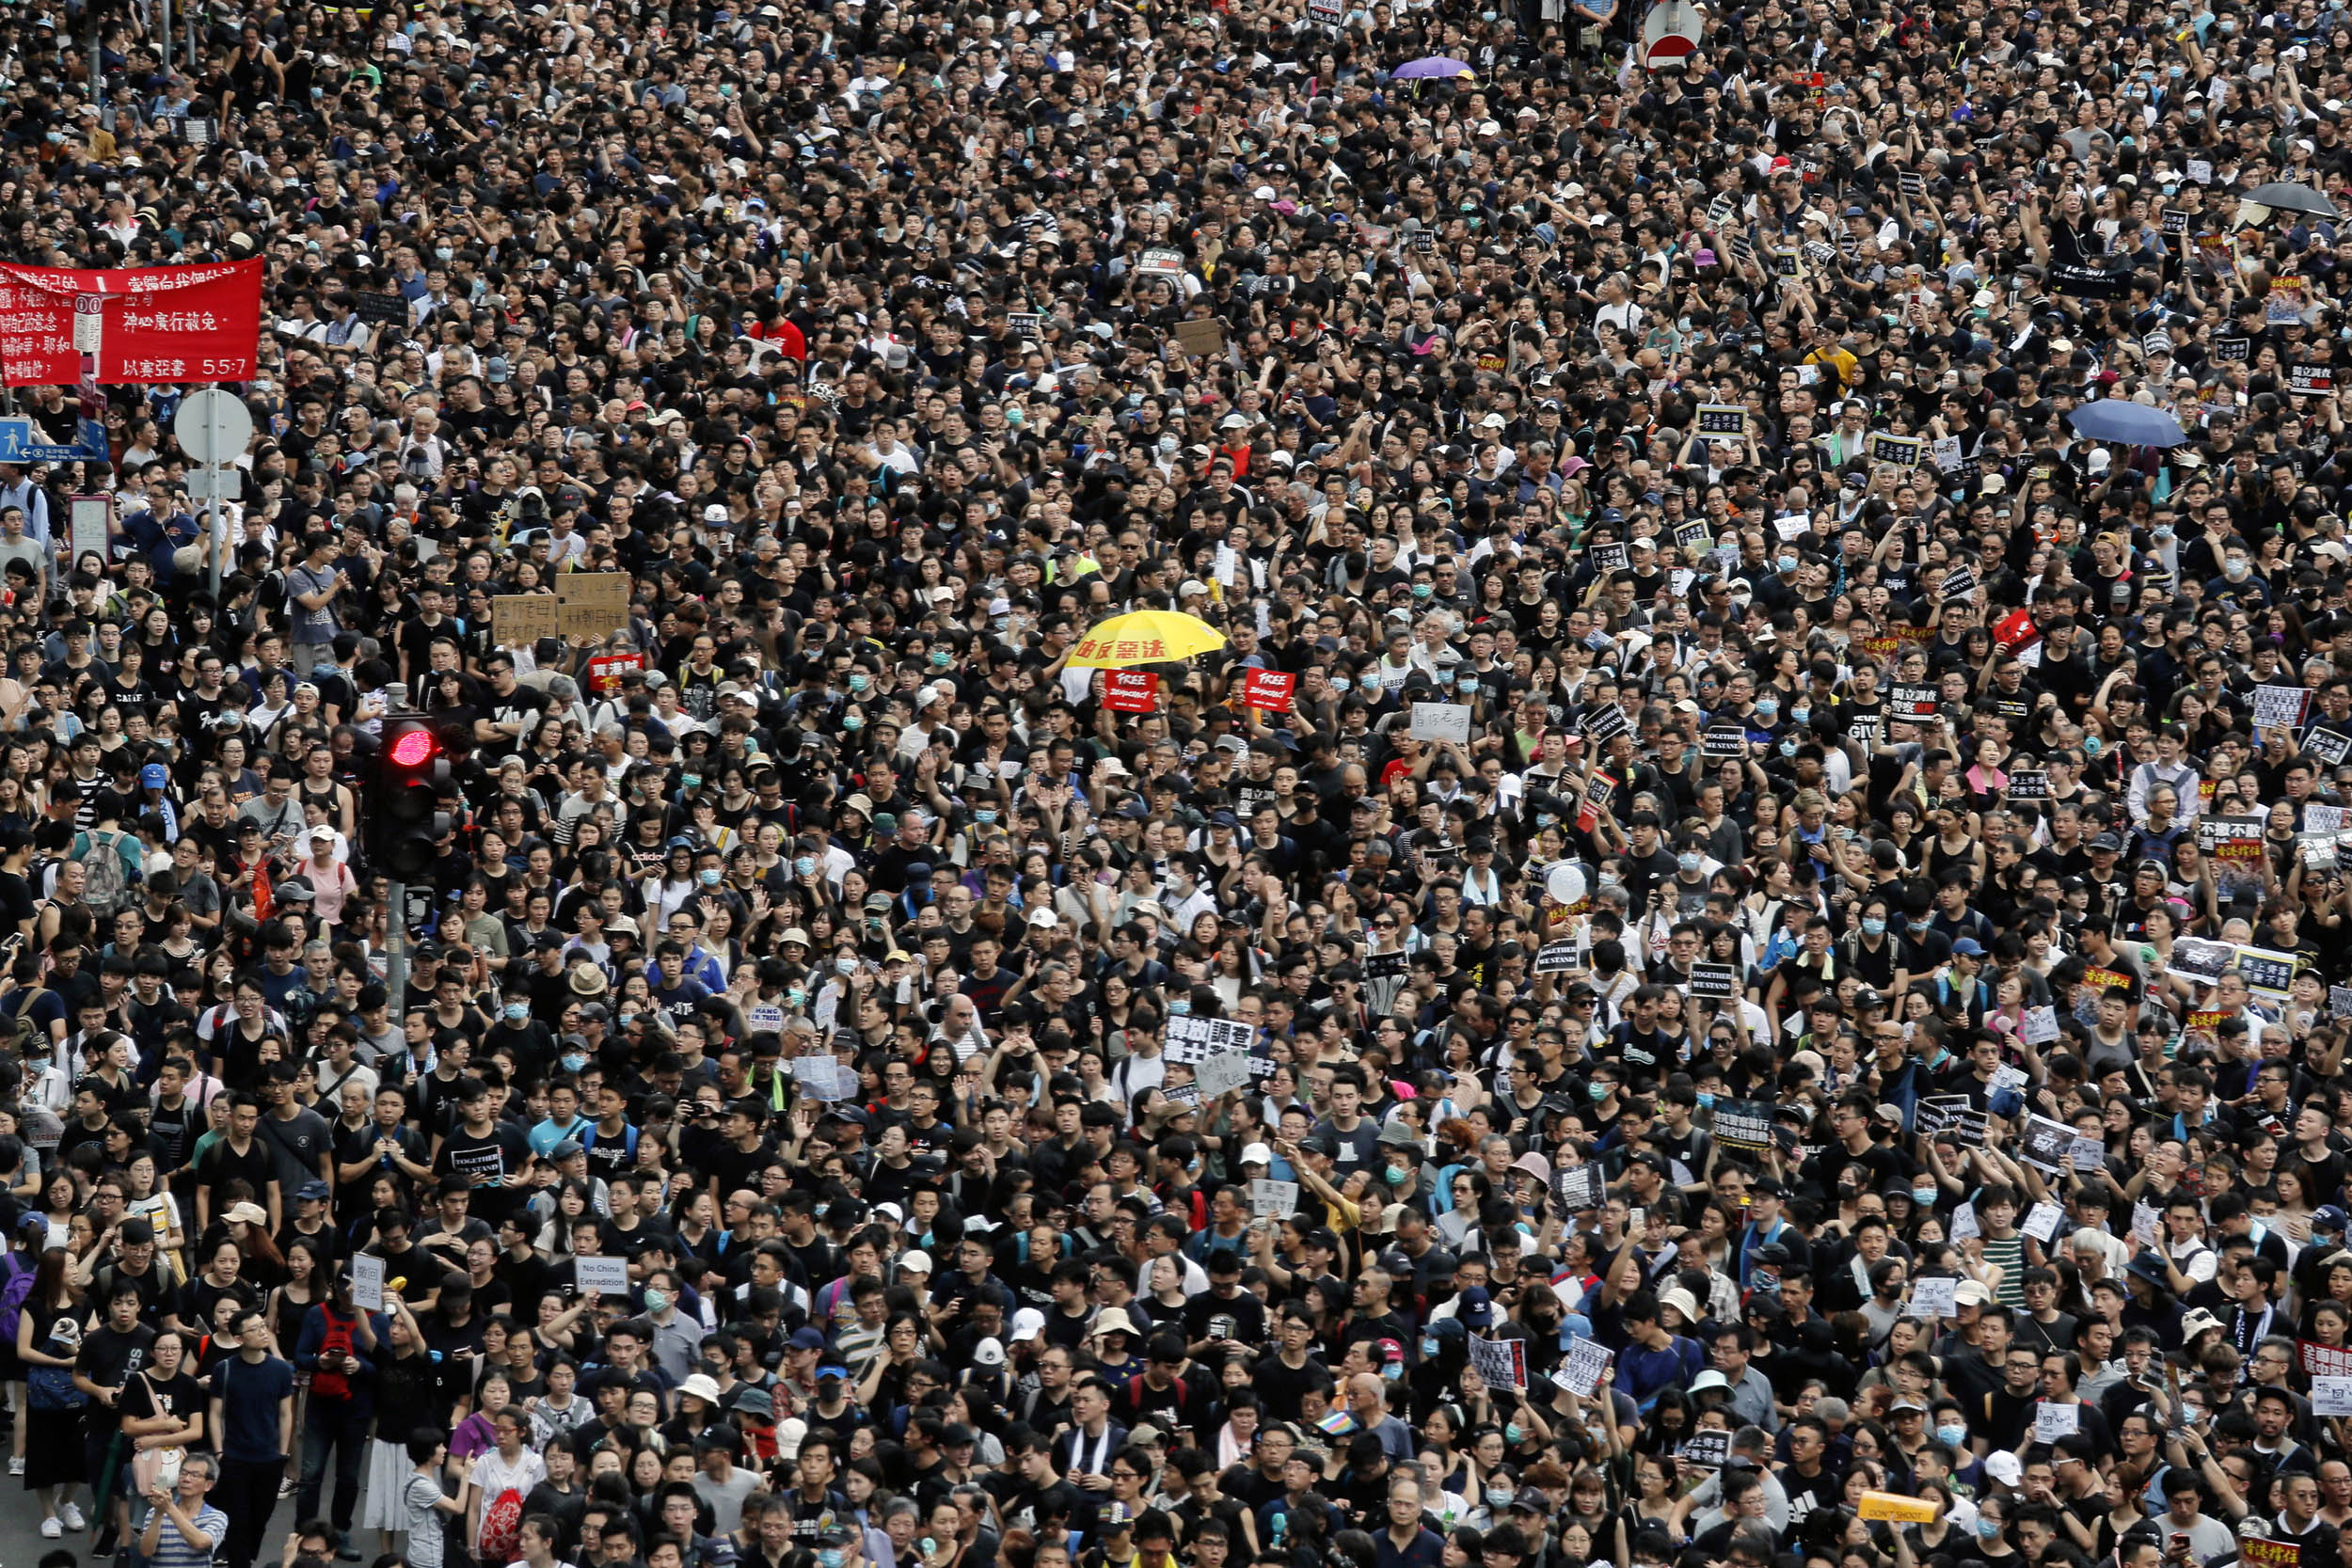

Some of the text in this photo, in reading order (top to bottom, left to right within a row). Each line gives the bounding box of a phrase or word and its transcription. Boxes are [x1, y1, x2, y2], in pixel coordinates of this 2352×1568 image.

[123, 359, 187, 378] 以賽亞書
[201, 358, 246, 376] 55:7
[2293, 366, 2331, 377] 獨立調查
[1703, 421, 1739, 431] 不撤不散
[1879, 442, 1914, 455] 齊上齊落
[1115, 673, 1146, 685] FREE
[1259, 673, 1288, 685] FREE
[1892, 688, 1937, 702] 獨立調查
[1240, 787, 1276, 800] 獨立調
[2200, 822, 2262, 838] 不撤不散
[1552, 956, 1577, 964] STAND
[2243, 958, 2289, 977] 齊上齊落
[1693, 972, 1732, 980] TOGETHER
[1706, 982, 1731, 990] STAND
[456, 1154, 499, 1165] TOGETHER
[596, 1264, 620, 1273] China
[580, 1277, 626, 1287] Extradition
[1895, 1510, 1922, 1520] SHOOT
[2244, 1539, 2297, 1563] 香港撐住
